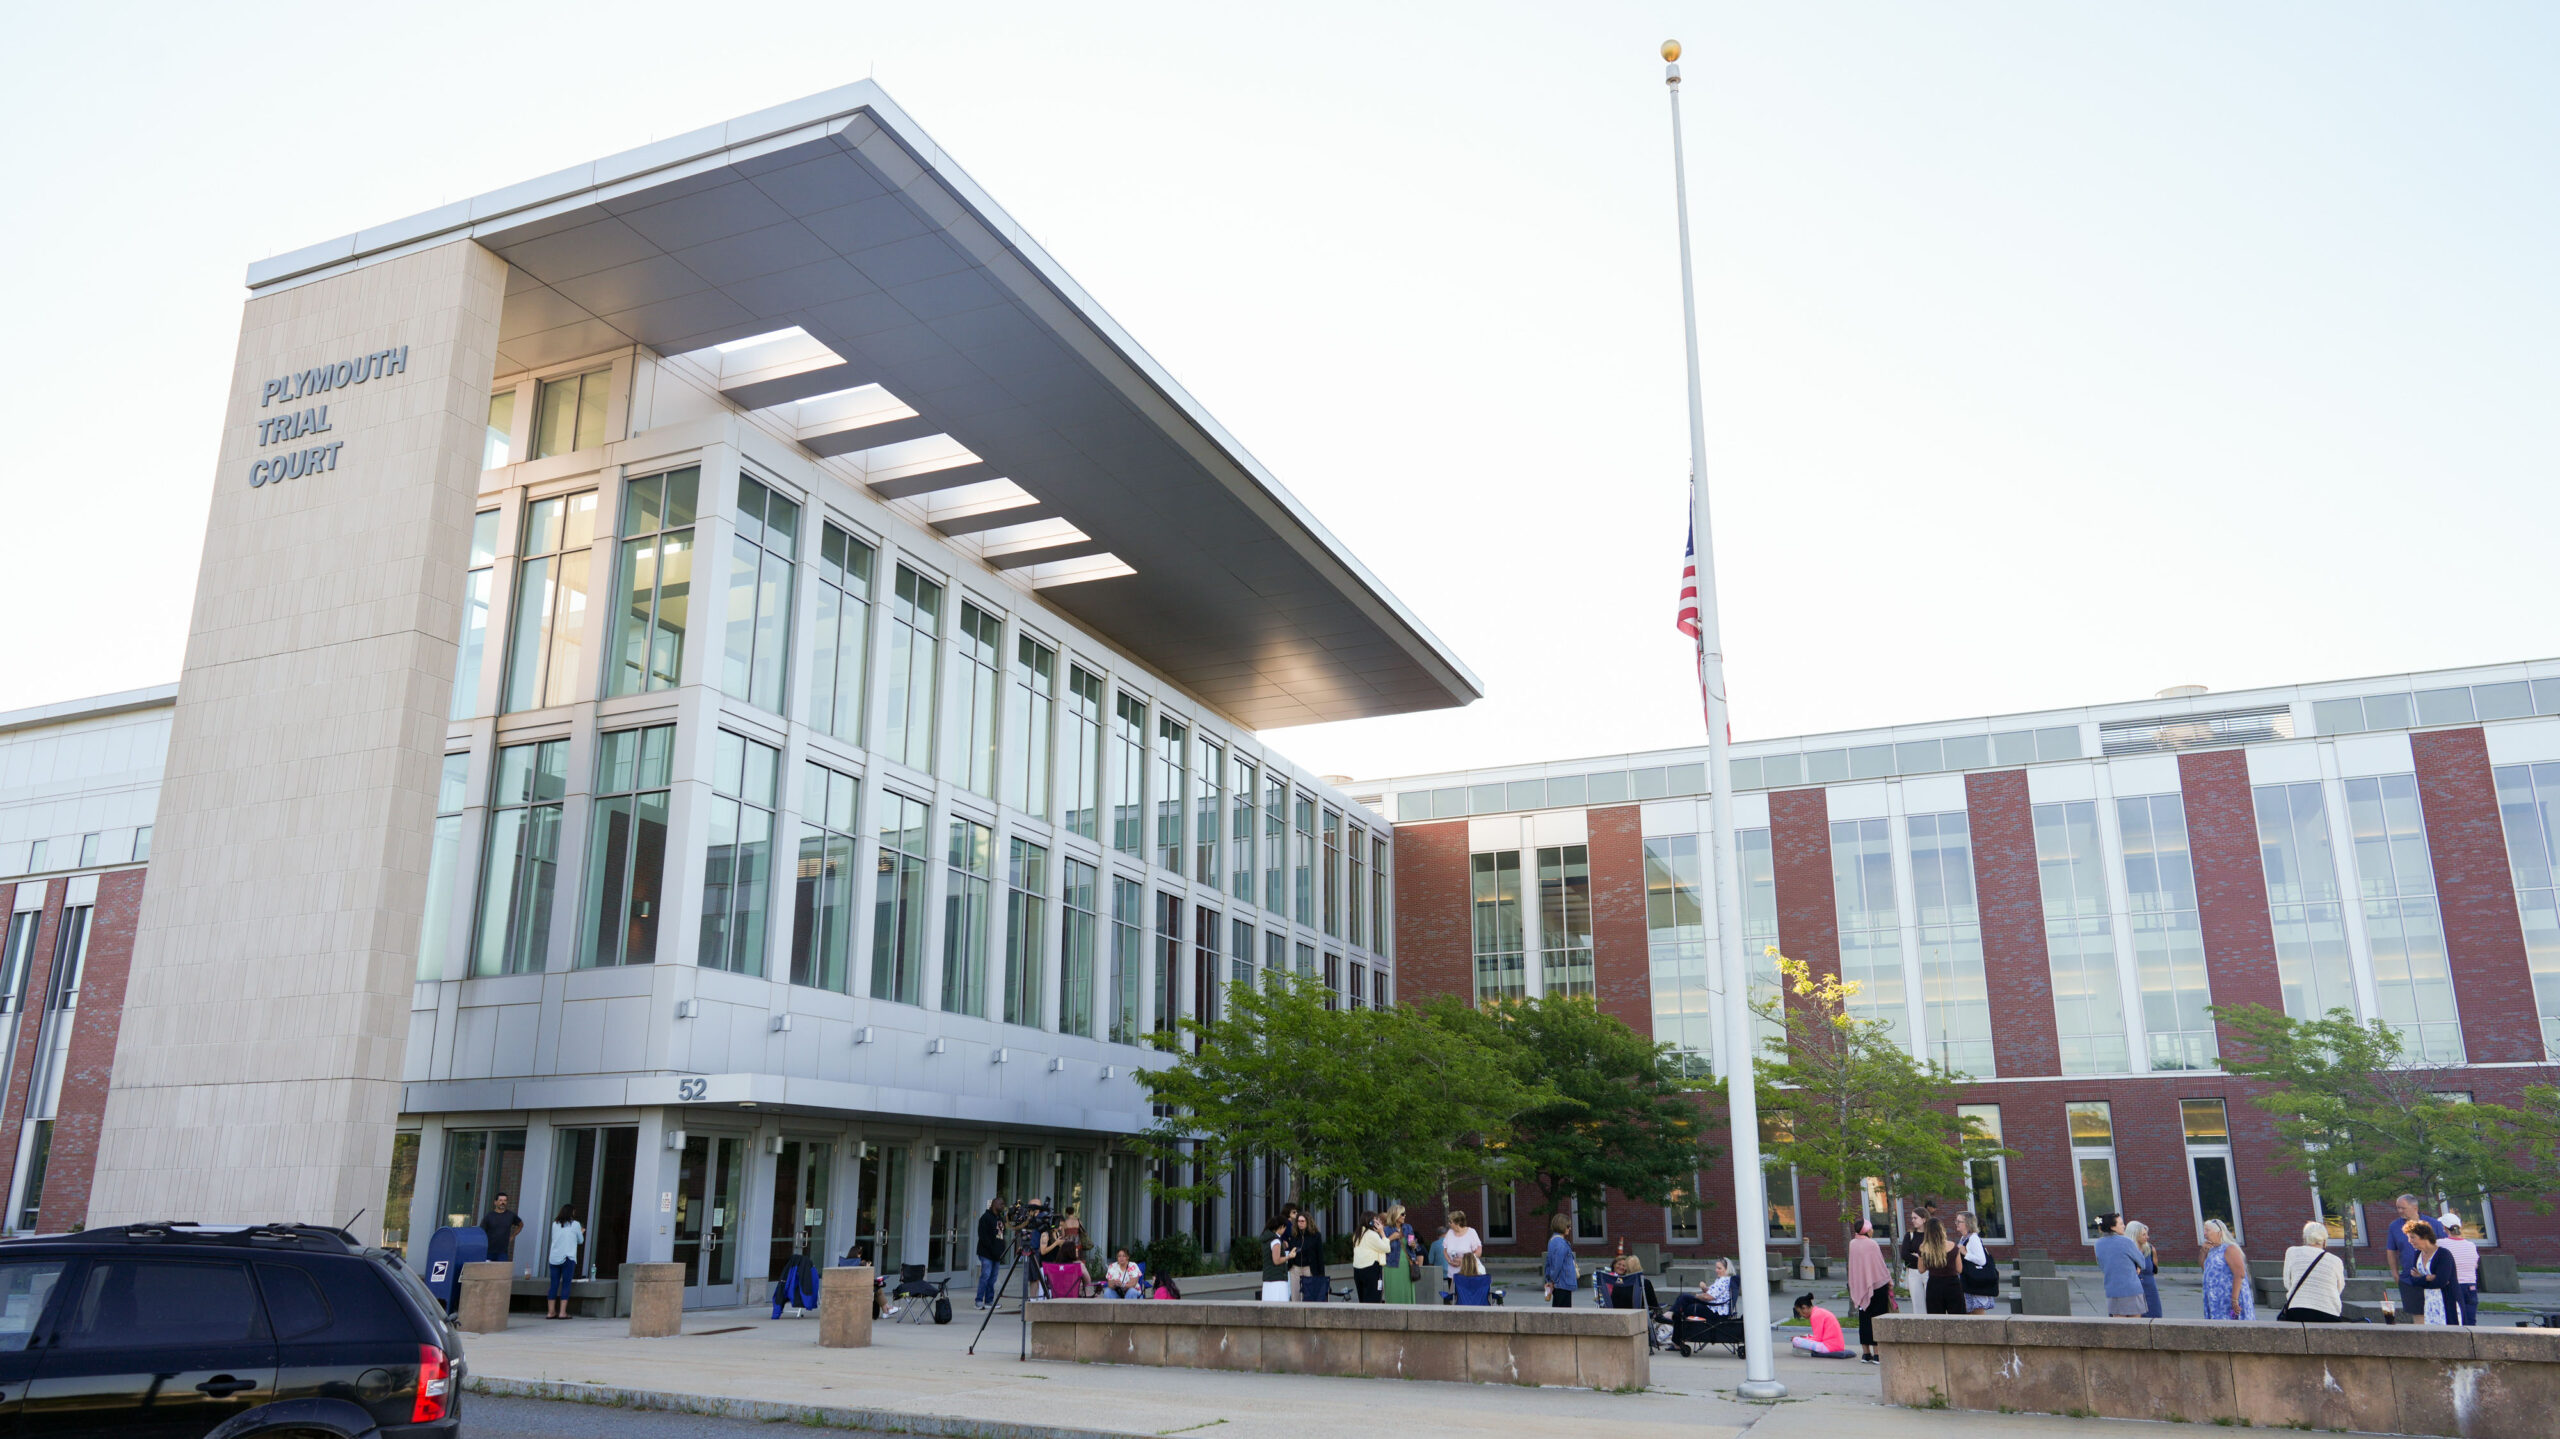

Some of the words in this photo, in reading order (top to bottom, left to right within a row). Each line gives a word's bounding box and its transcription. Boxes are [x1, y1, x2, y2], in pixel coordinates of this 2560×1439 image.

[261, 345, 408, 407] PLYMOUTH
[258, 405, 332, 446] TRIAL
[249, 440, 344, 488] COURT
[678, 1078, 707, 1101] 52
